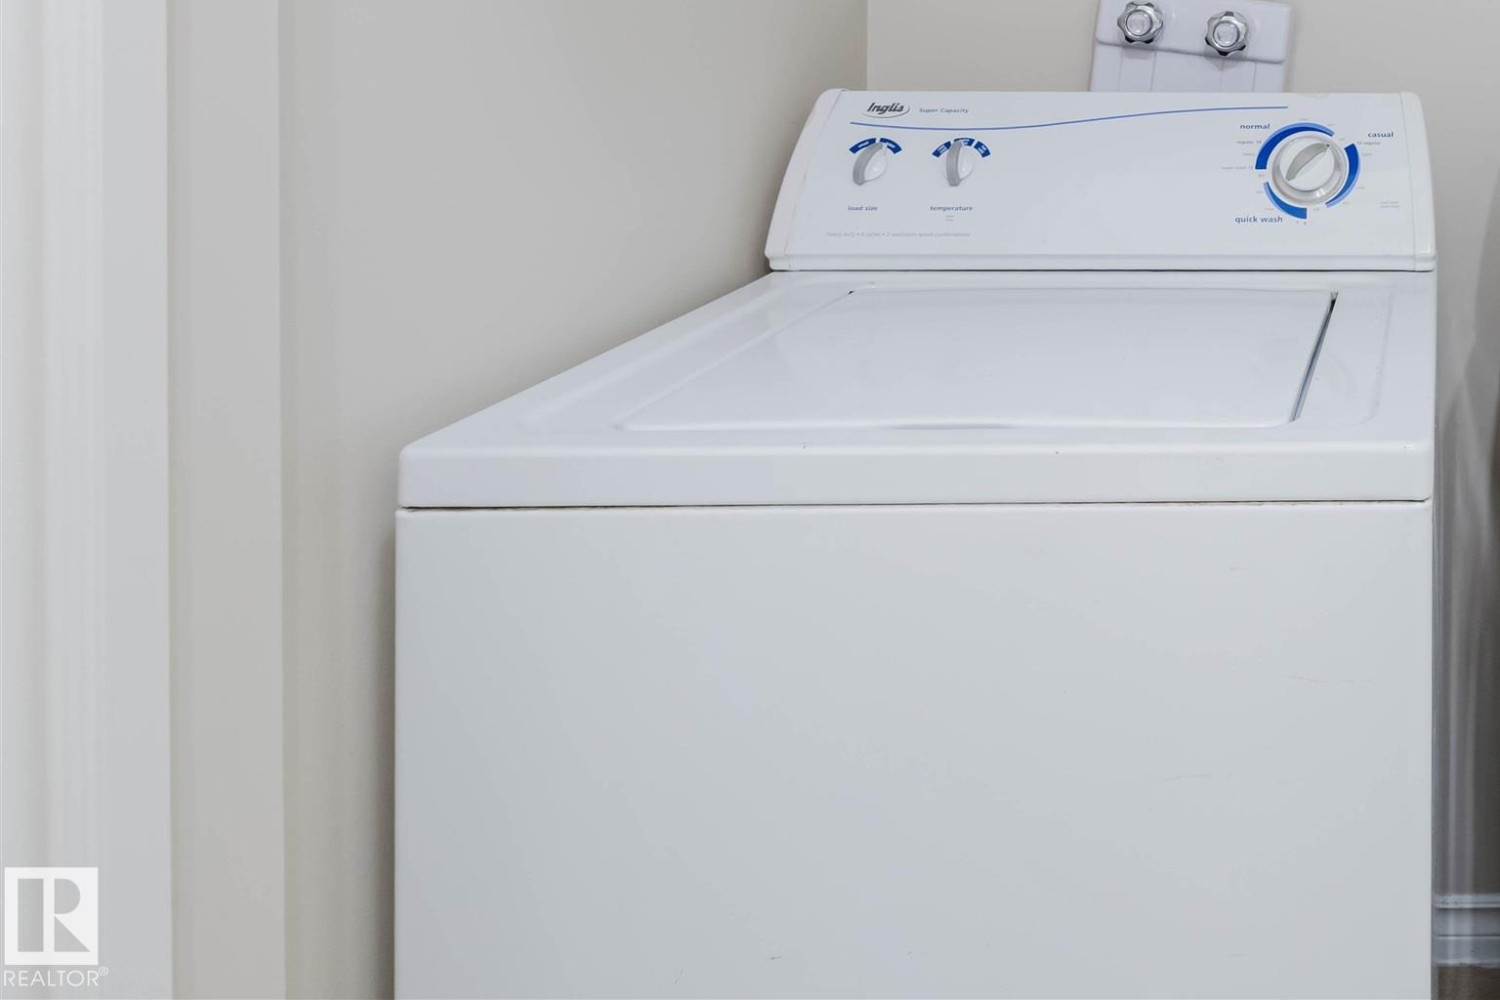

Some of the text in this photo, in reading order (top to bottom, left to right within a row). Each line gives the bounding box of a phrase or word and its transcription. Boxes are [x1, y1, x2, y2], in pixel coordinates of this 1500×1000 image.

[867, 102, 905, 115] Inglis
[1234, 215, 1283, 224] quick wash
